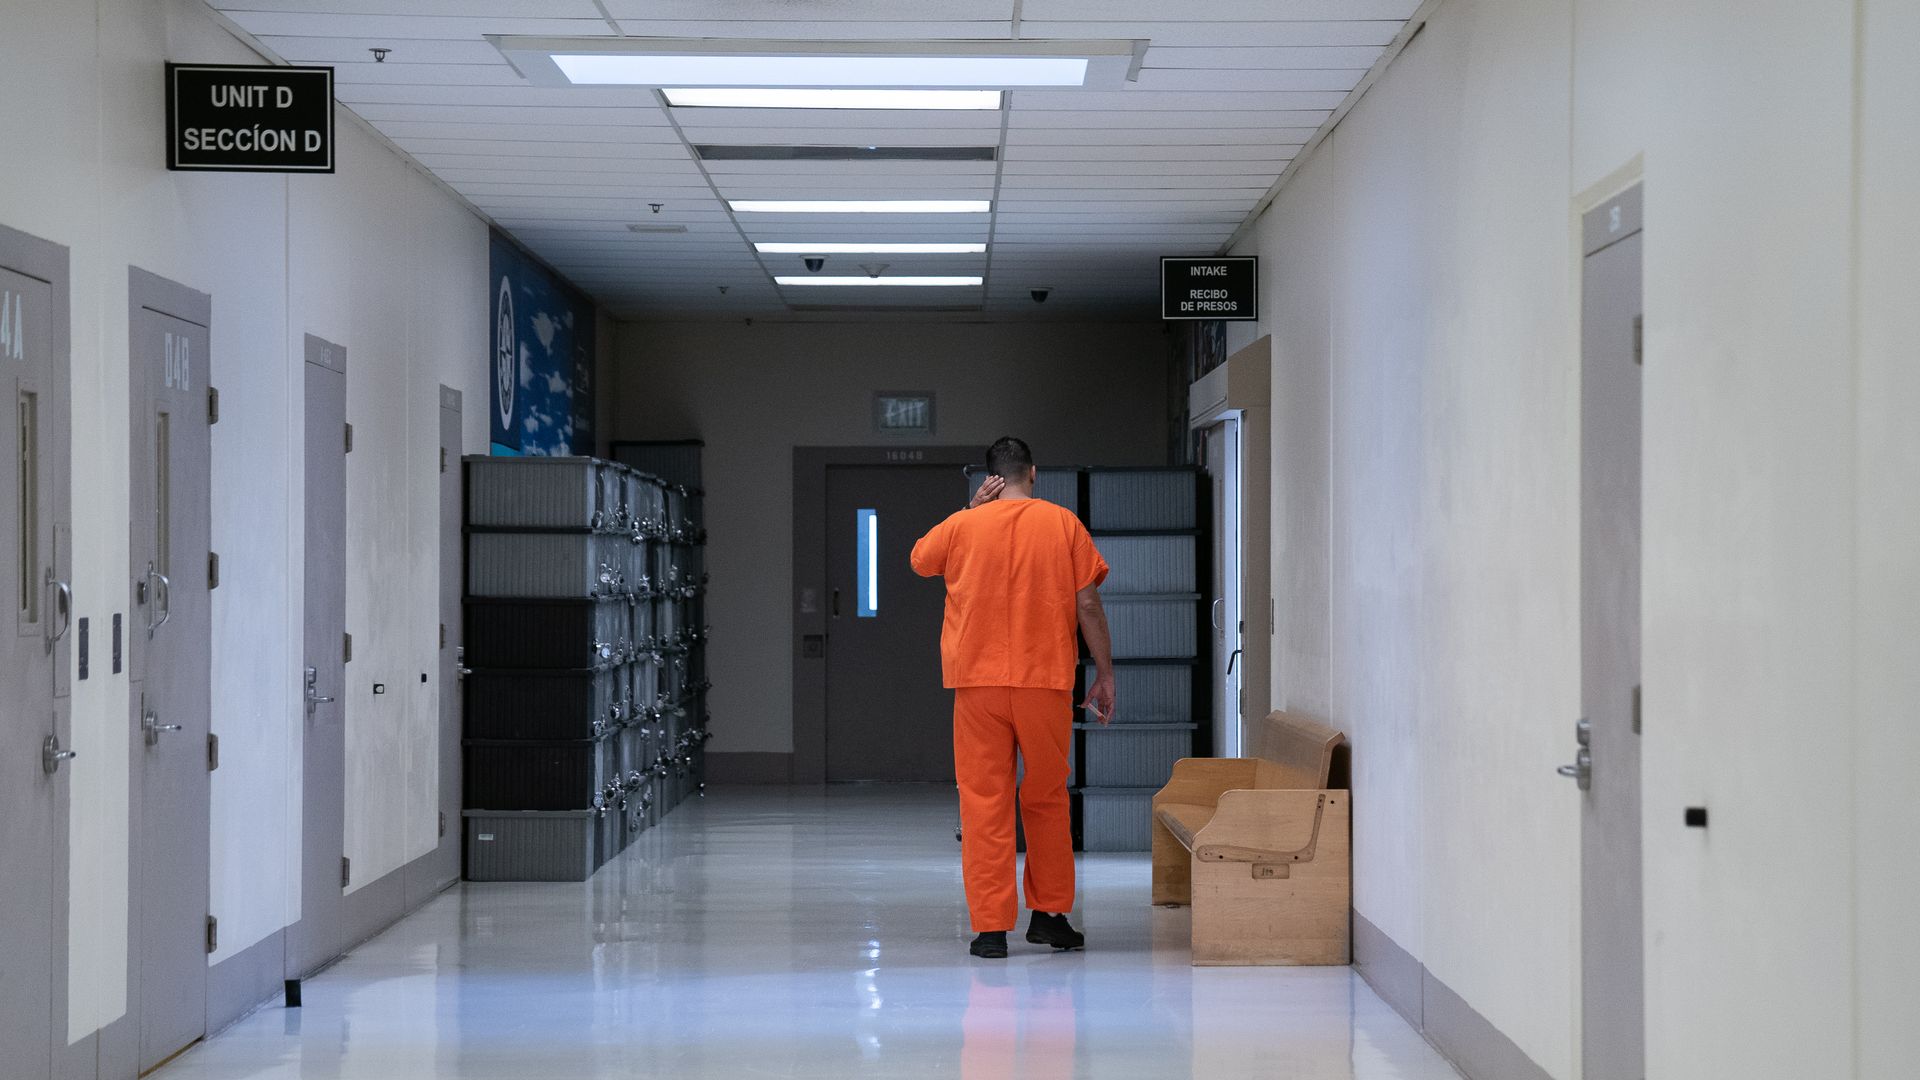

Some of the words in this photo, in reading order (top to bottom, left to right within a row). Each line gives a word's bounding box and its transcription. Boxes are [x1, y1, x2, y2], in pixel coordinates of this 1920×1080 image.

[211, 85, 269, 108] UNIT
[276, 86, 293, 108] D
[183, 124, 296, 152] SECCÍON
[304, 130, 322, 152] D
[1190, 266, 1228, 276] INTAKE
[1190, 289, 1228, 299] RECIBO
[1180, 301, 1194, 311] DE
[1196, 301, 1238, 311] PRESOS
[165, 332, 189, 391] D4B
[886, 399, 924, 427] EXIT
